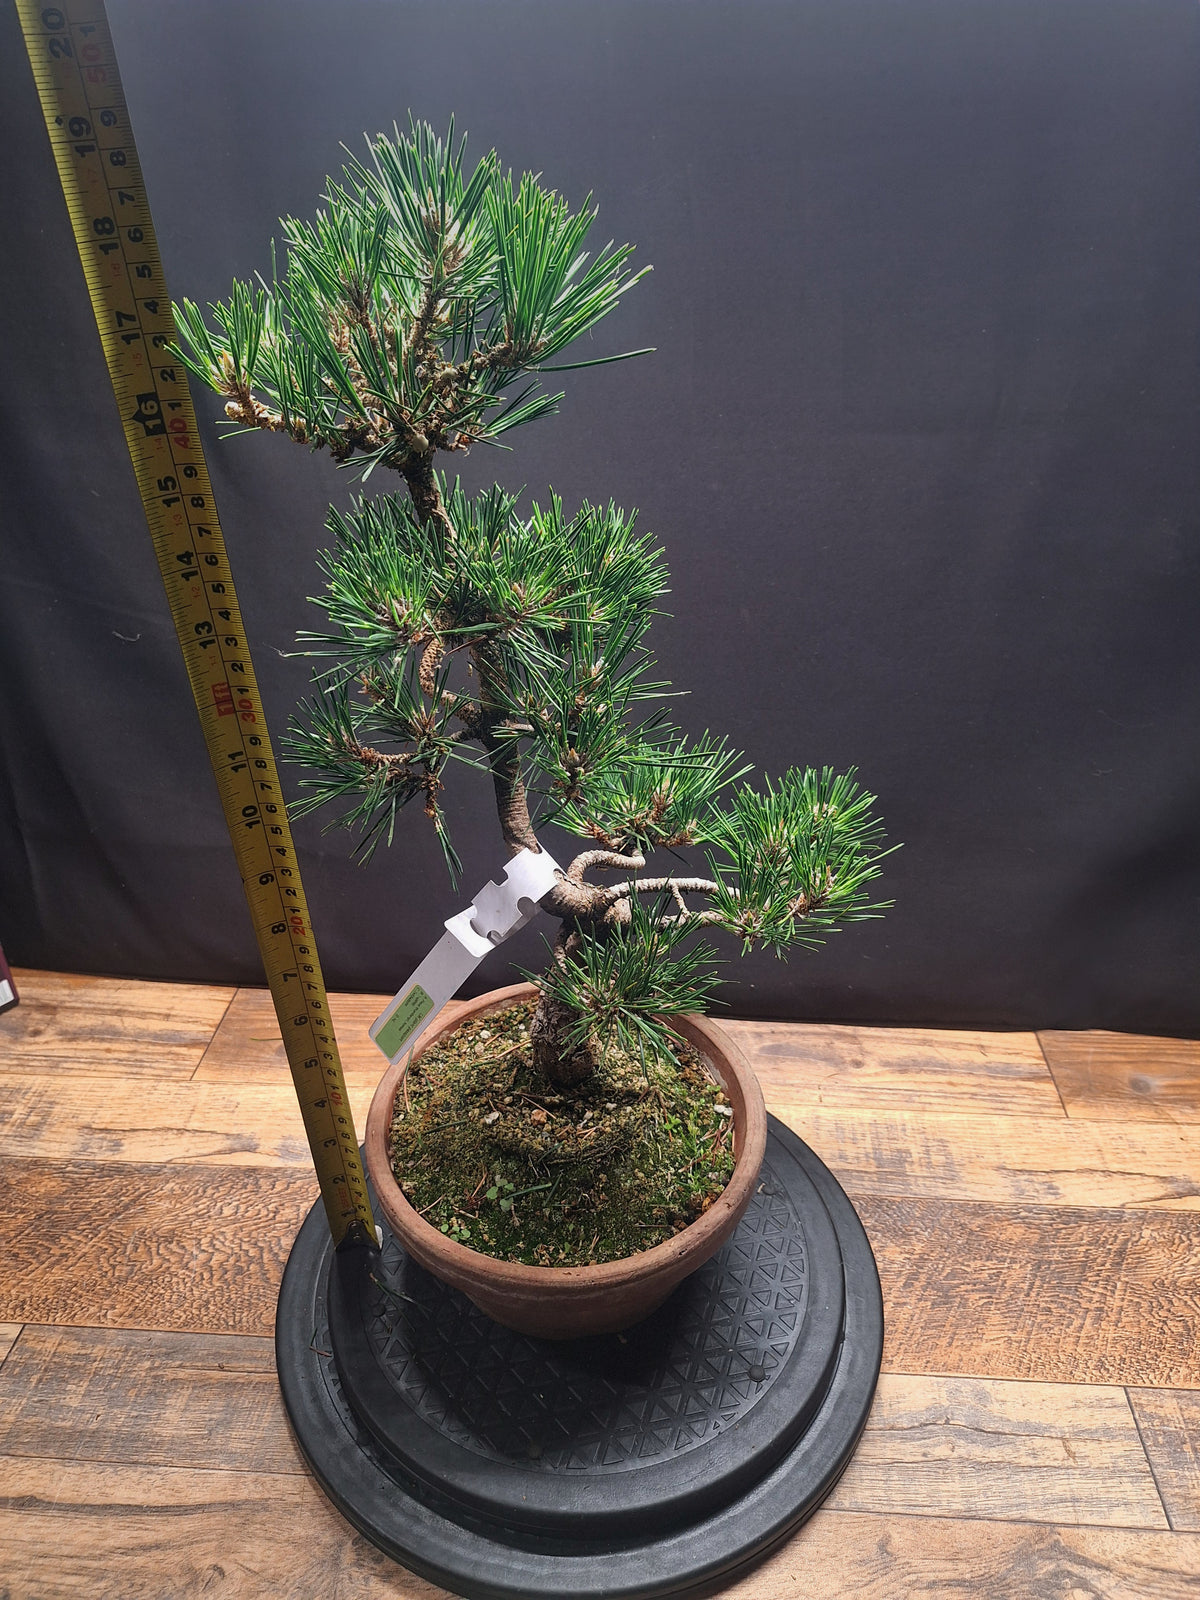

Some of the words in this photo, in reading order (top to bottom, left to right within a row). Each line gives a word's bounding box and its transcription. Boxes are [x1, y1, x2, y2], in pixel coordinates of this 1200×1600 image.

[42, 8, 72, 58] 20
[82, 44, 107, 83] 50
[100, 110, 117, 127] 9
[69, 116, 96, 158] 19
[110, 151, 126, 166] 8
[118, 191, 135, 206] 7
[93, 216, 119, 255] 18
[128, 227, 144, 243] 6
[136, 264, 152, 278] 5
[144, 300, 160, 314] 4
[115, 311, 141, 346] 17
[152, 335, 168, 349] 3
[160, 369, 176, 382] 2
[167, 402, 182, 411] 1
[141, 400, 162, 430] 16
[169, 417, 190, 449] 40
[183, 466, 198, 479] 9
[157, 475, 180, 508] 15
[191, 496, 205, 509] 8
[197, 526, 212, 537] 7
[176, 550, 199, 582] 14
[205, 554, 219, 567] 6
[211, 583, 225, 594] 5
[218, 610, 231, 621] 4
[194, 621, 216, 650] 13
[225, 636, 238, 647] 3
[231, 662, 244, 673] 2
[238, 699, 256, 723] 30
[249, 736, 261, 746] 9
[227, 751, 247, 773] 11
[255, 760, 267, 769] 8
[260, 783, 272, 791] 7
[265, 805, 277, 813] 6
[242, 805, 261, 829] 10
[271, 827, 282, 835] 5
[275, 847, 287, 856] 4
[259, 873, 275, 885] 9
[285, 889, 297, 897] 2
[271, 923, 286, 935] 8
[290, 916, 306, 936] 20
[299, 946, 309, 954] 9
[303, 965, 314, 973] 8
[282, 972, 297, 982] 7
[312, 1001, 321, 1009] 6
[293, 1015, 308, 1026] 6
[304, 1059, 318, 1069] 5
[327, 1069, 336, 1077] 2
[314, 1100, 327, 1108] 4
[330, 1091, 342, 1106] 10
[323, 1138, 337, 1149] 3
[348, 1161, 357, 1169] 6
[333, 1175, 345, 1184] 2
